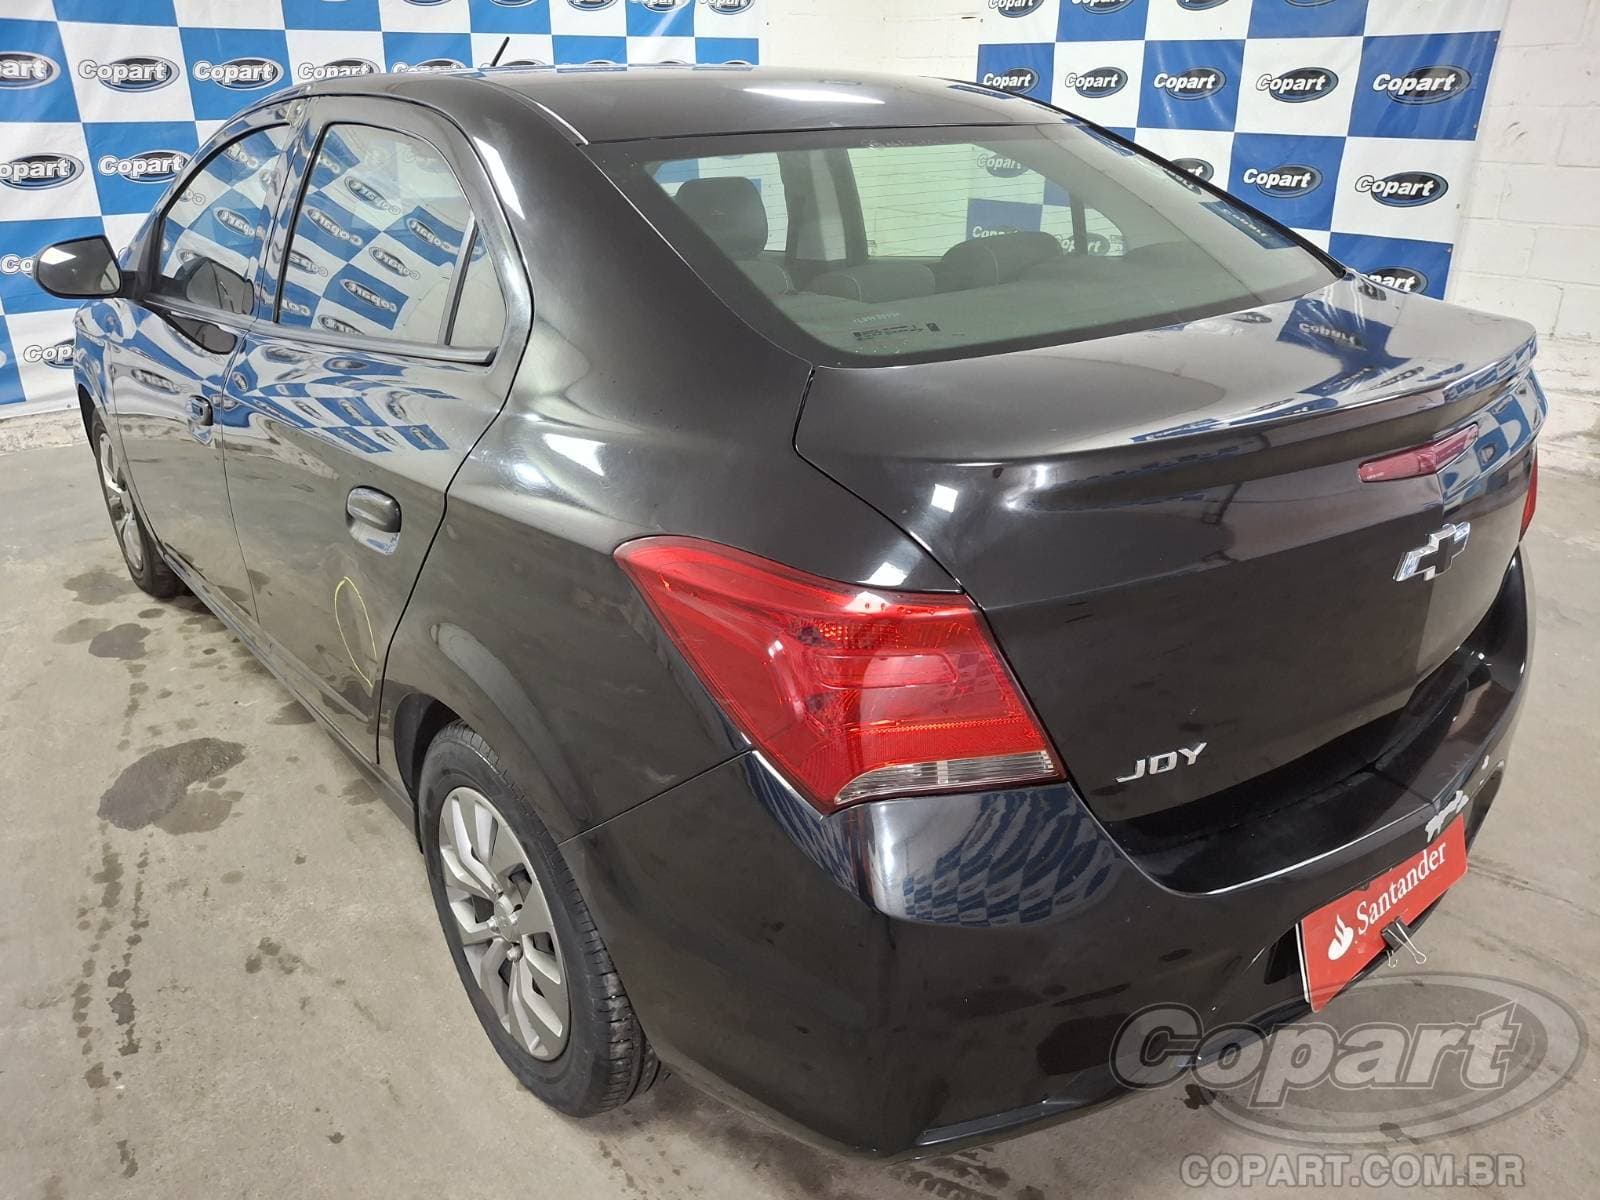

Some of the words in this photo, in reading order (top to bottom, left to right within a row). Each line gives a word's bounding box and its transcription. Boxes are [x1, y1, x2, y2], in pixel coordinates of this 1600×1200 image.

[0, 58, 48, 81] art
[78, 58, 169, 85] Copart
[193, 59, 276, 84] Copart
[982, 72, 1032, 93] Copart
[1065, 72, 1119, 94] Copart
[1153, 72, 1217, 94] Copart
[1256, 73, 1327, 96] Copart
[1371, 72, 1457, 95] Copart
[98, 154, 184, 179] Copart
[1243, 168, 1312, 189] Copart
[1355, 175, 1436, 197] Copart
[1115, 742, 1208, 784] JOY
[1356, 842, 1448, 935] Santander
